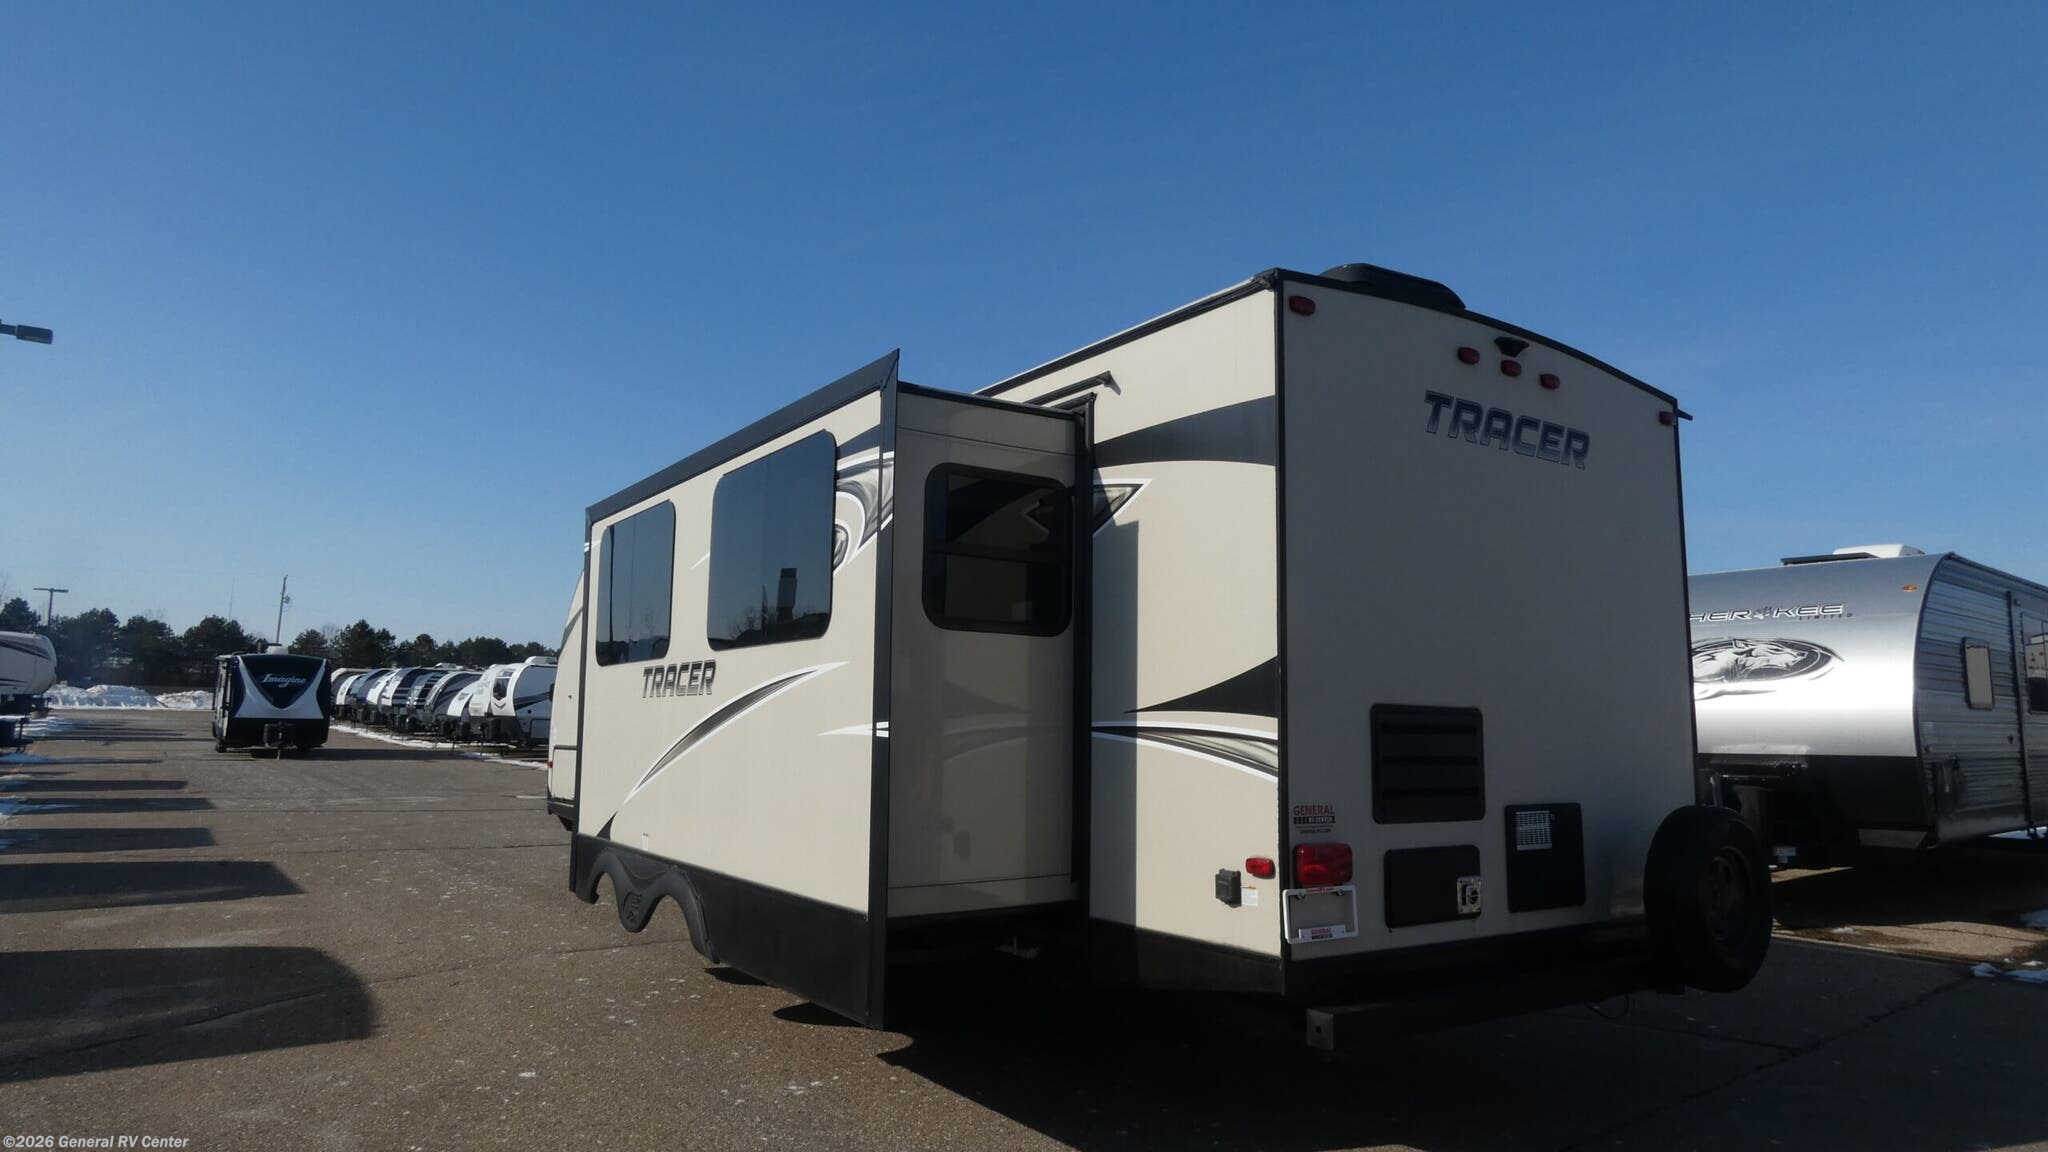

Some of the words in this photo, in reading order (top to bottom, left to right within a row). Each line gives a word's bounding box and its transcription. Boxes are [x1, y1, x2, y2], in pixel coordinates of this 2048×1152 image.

[1424, 389, 1590, 470] TRACER
[261, 673, 307, 688] Imagine
[642, 660, 716, 698] TRACER
[1293, 804, 1336, 816] GENERAL
